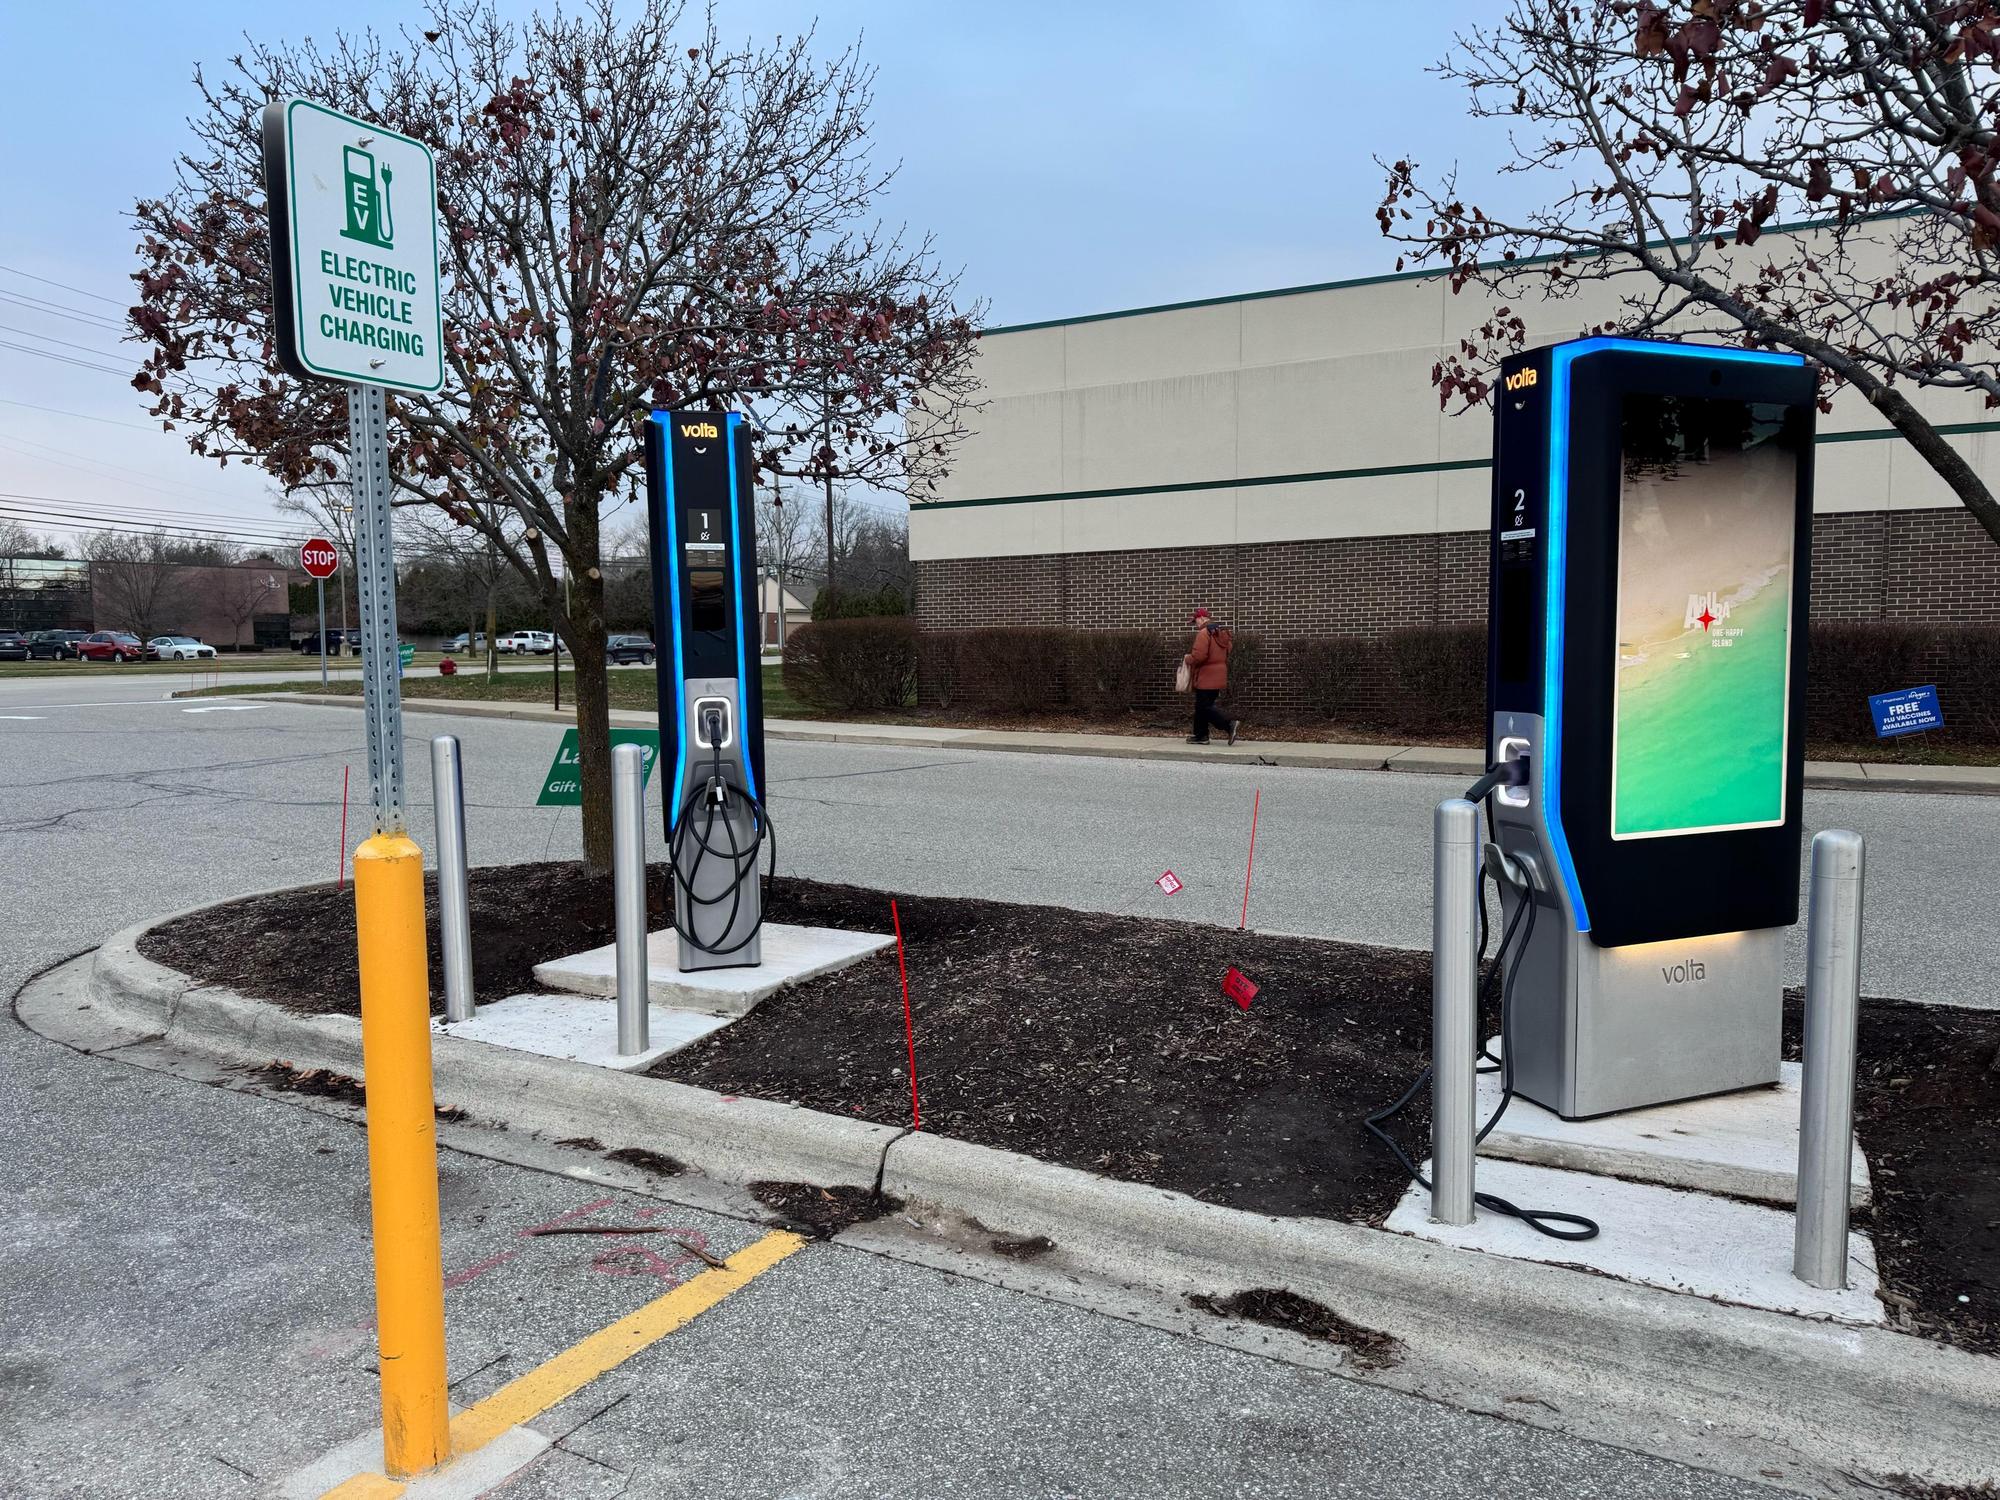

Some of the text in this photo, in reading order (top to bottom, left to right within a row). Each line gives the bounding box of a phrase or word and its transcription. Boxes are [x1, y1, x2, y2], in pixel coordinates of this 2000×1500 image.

[320, 249, 417, 295] ELECTRIC
[329, 283, 413, 325] VEHICLE
[320, 313, 424, 357] CHARGING
[1505, 366, 1537, 391] volta
[681, 422, 718, 438] volta
[1514, 488, 1525, 511] 2
[701, 512, 709, 529] 1
[304, 549, 336, 566] STOP
[1711, 639, 1733, 647] ISLAND
[1882, 719, 1918, 731] AVAILABLE
[1918, 716, 1936, 724] NOW
[1883, 710, 1932, 724] FLU VACCINES
[548, 780, 577, 793] Gift
[1662, 958, 1706, 985] volta
